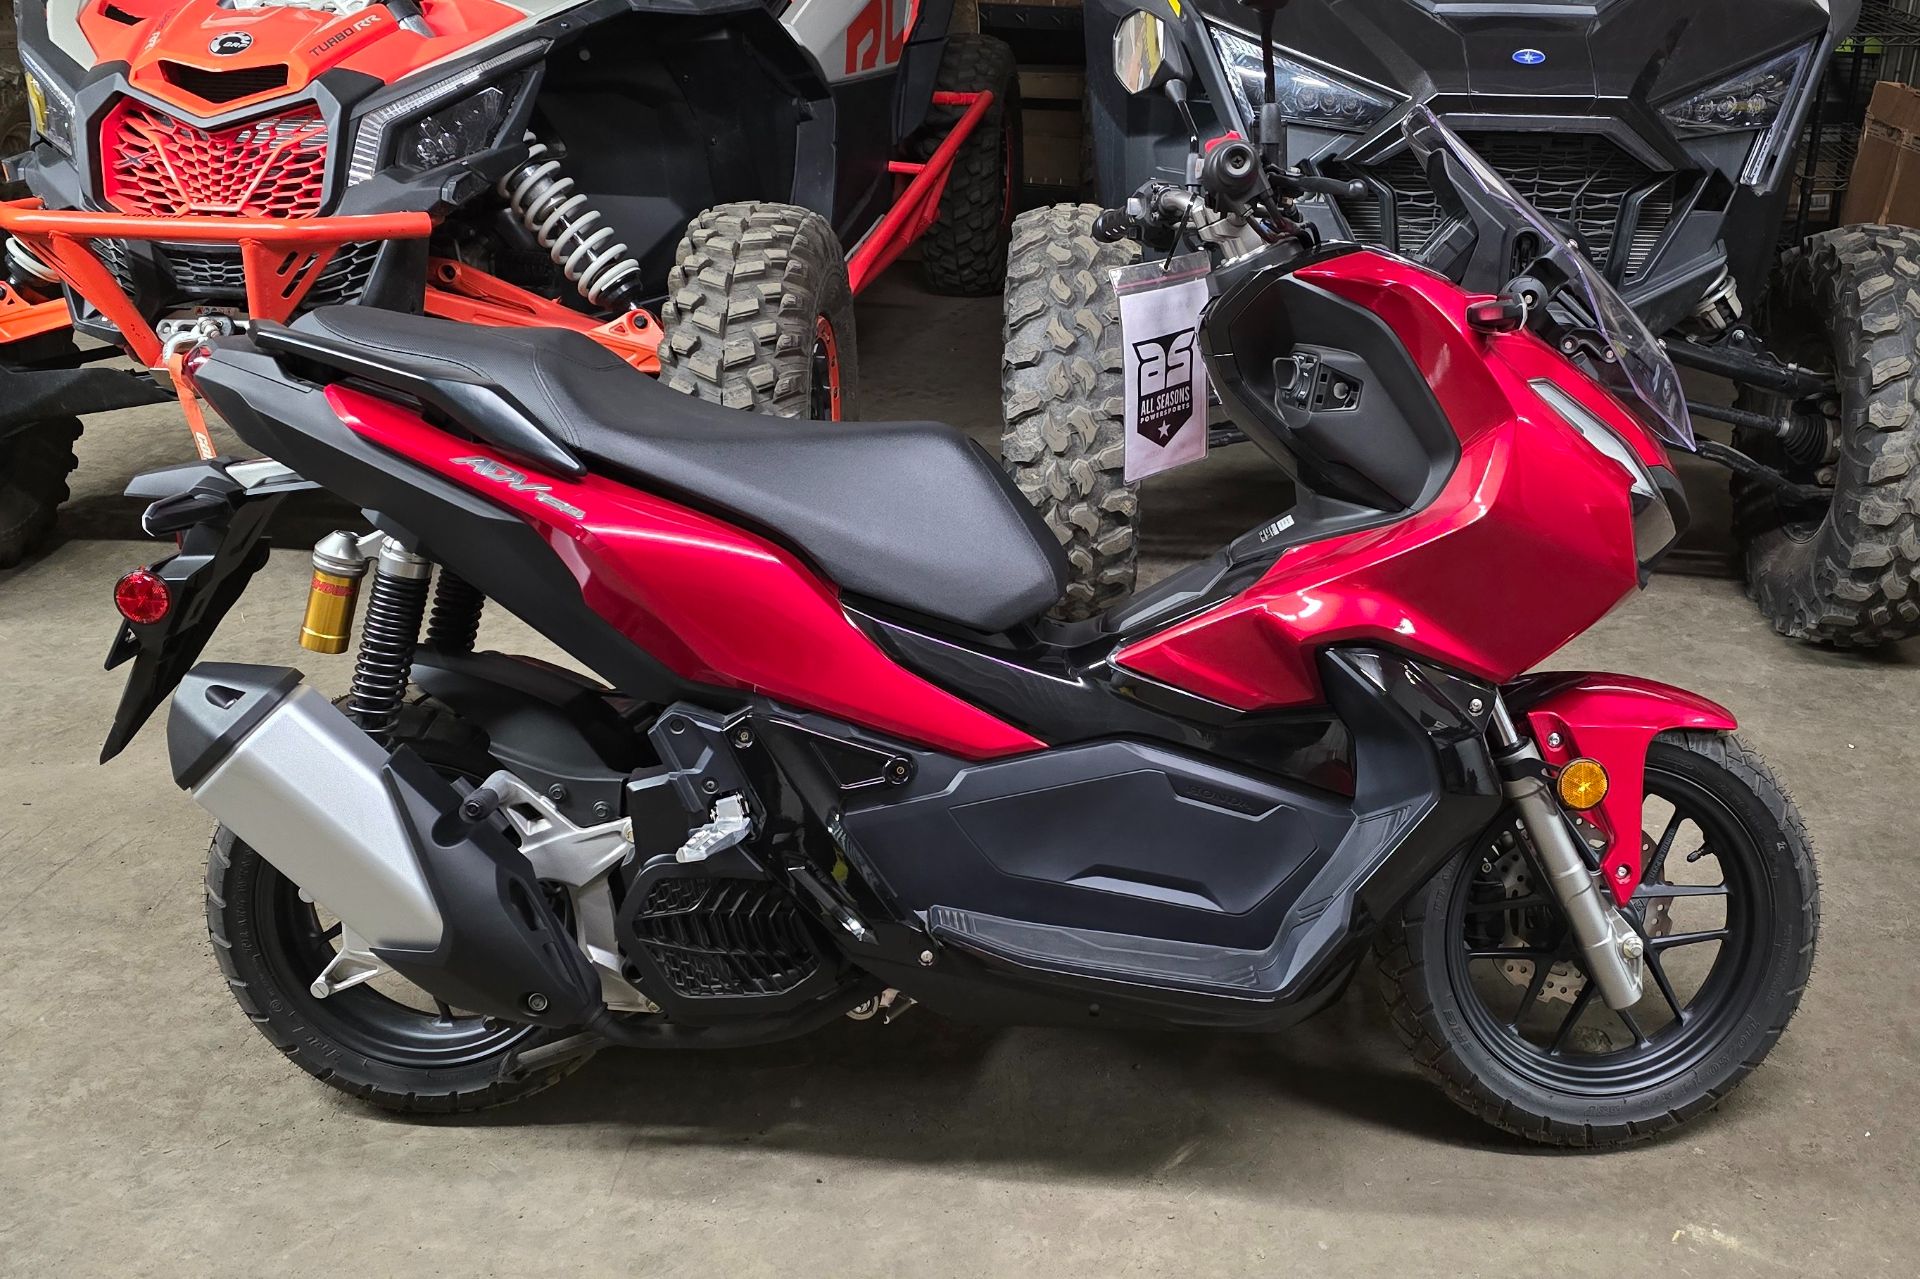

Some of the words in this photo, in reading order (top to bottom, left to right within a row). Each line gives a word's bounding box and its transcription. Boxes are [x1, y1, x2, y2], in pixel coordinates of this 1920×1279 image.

[222, 41, 249, 49] BRP
[309, 27, 355, 56] TURBO
[353, 14, 382, 31] RR
[1139, 402, 1190, 424] POWERSPORTS
[1140, 397, 1155, 416] ALL
[1156, 386, 1190, 411] SEASONS
[449, 455, 553, 492] ADV
